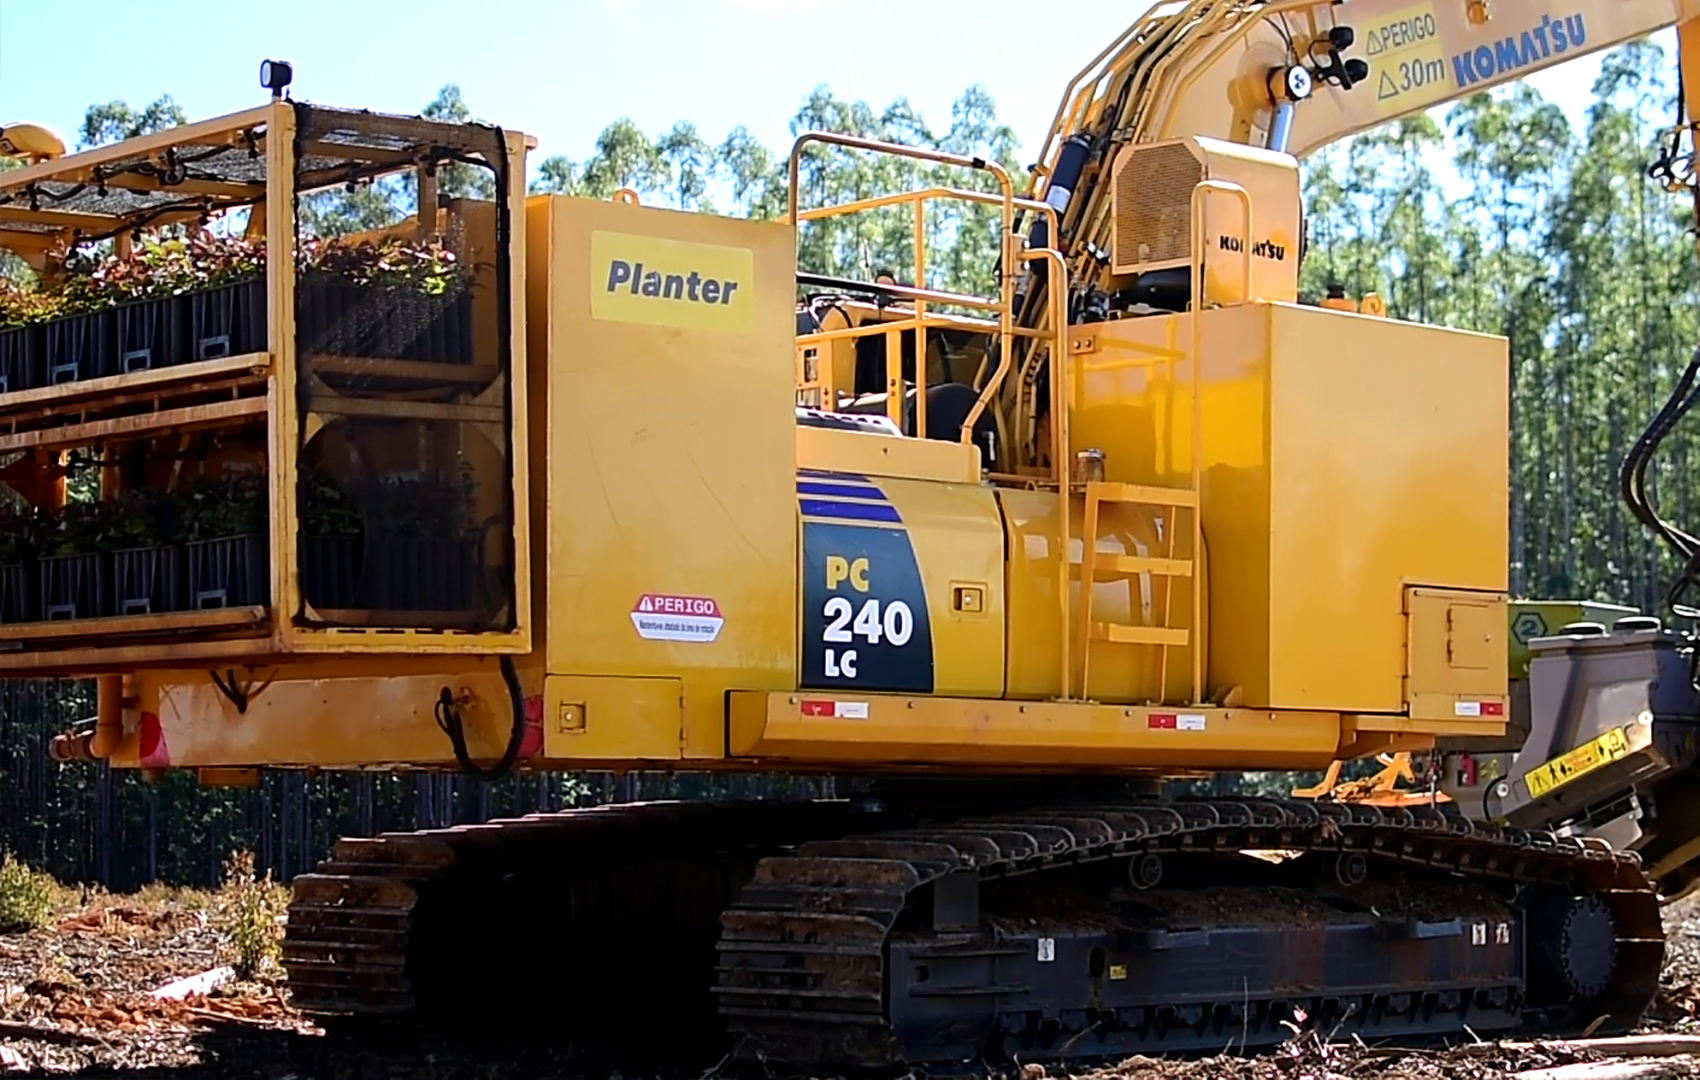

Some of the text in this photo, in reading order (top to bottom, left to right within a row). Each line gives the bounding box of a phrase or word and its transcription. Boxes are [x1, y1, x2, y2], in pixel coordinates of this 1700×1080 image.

[1380, 13, 1435, 51] PERIGO
[1452, 12, 1585, 88] KOMATSU
[1399, 58, 1445, 91] 30m
[607, 259, 738, 305] Planter
[826, 556, 869, 592] PC
[654, 597, 715, 614] PERIGO
[823, 597, 913, 646] 240
[1521, 620, 1538, 636] 2
[825, 649, 857, 678] LC
